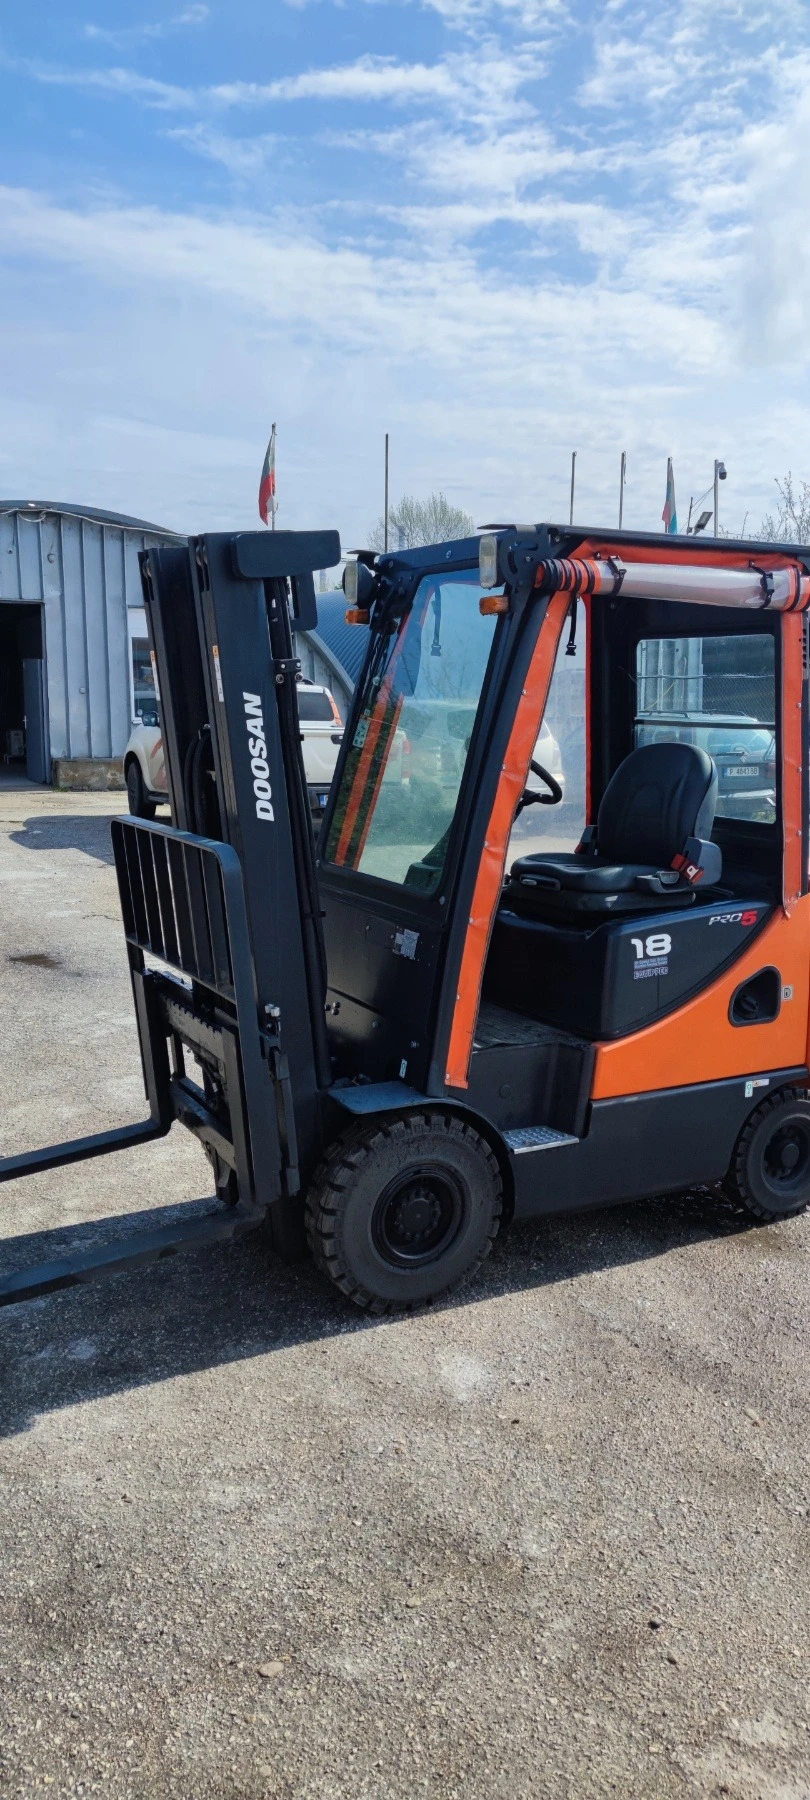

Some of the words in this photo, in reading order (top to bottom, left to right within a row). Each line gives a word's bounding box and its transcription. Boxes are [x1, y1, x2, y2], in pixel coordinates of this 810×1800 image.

[242, 691, 275, 822] DOOSAN
[708, 910, 758, 926] PRO5
[631, 933, 672, 959] 18
